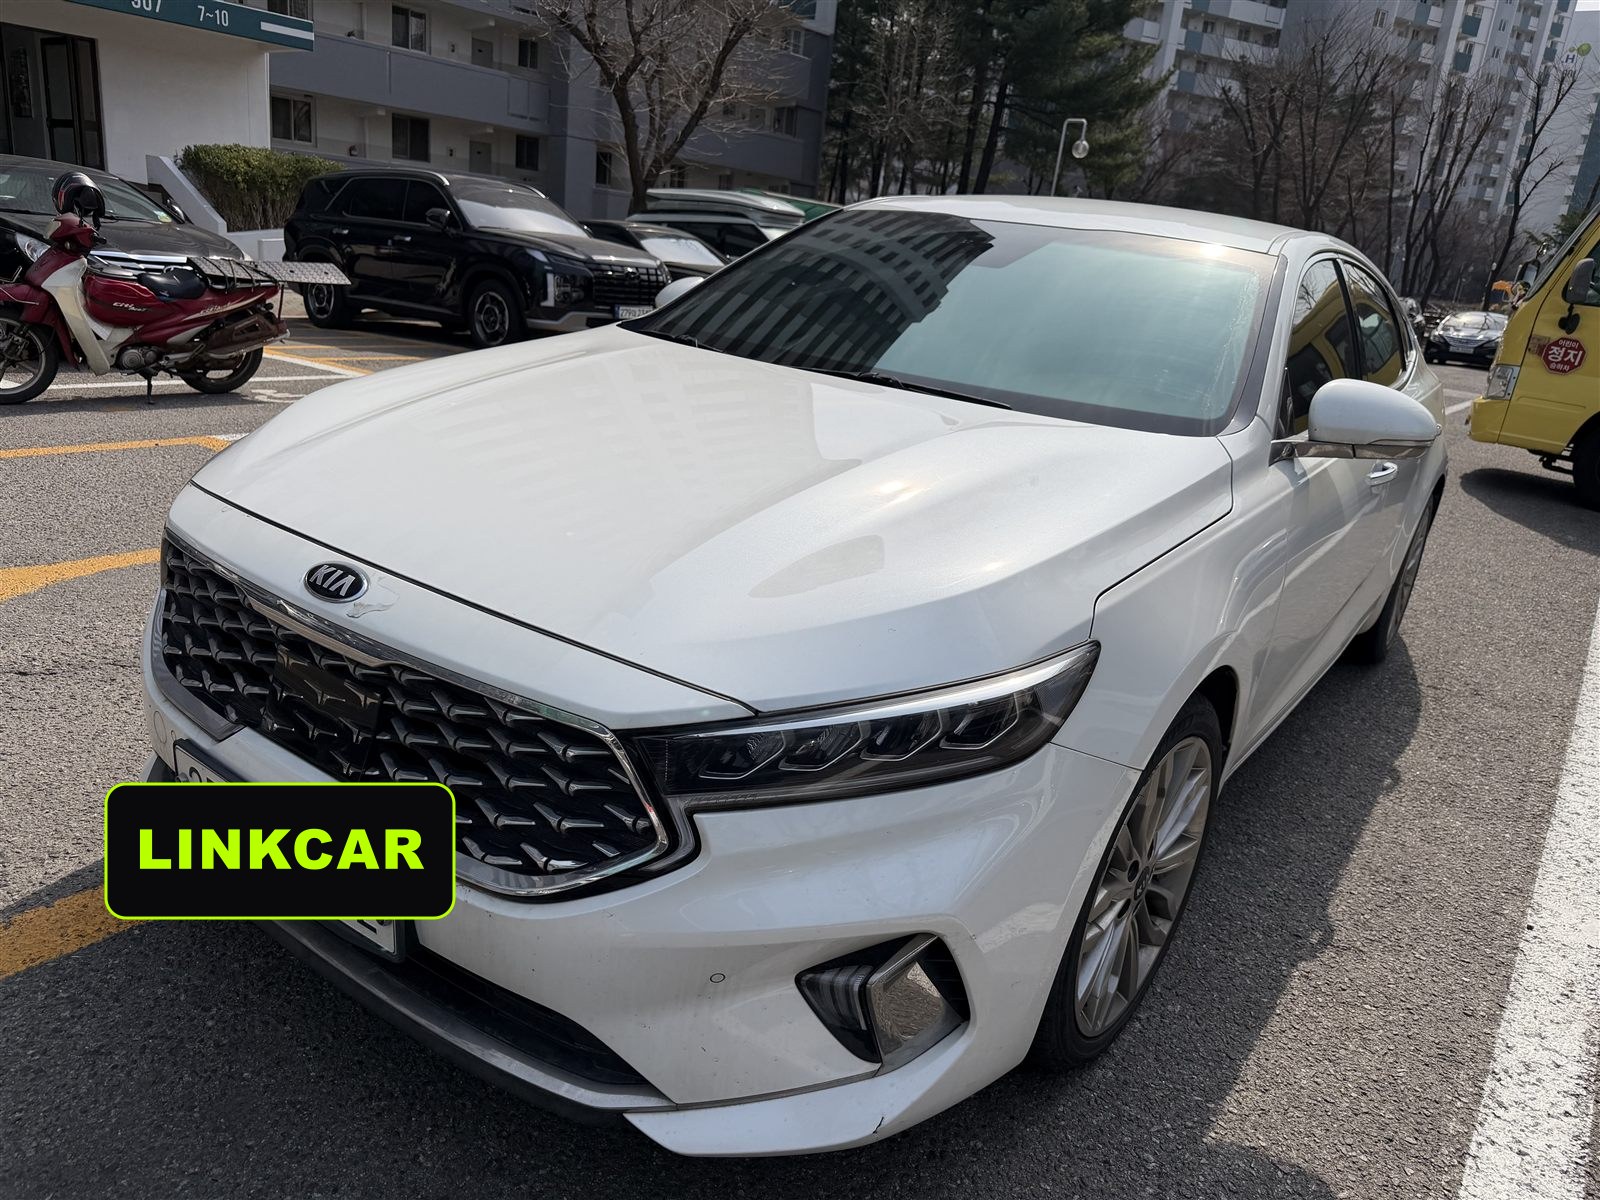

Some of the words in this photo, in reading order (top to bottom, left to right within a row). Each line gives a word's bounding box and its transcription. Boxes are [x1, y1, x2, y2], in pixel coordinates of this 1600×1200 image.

[198, 5, 229, 27] 7~10
[1558, 339, 1579, 349] 어린이
[1547, 346, 1583, 366] 정지
[309, 564, 356, 597] KIA
